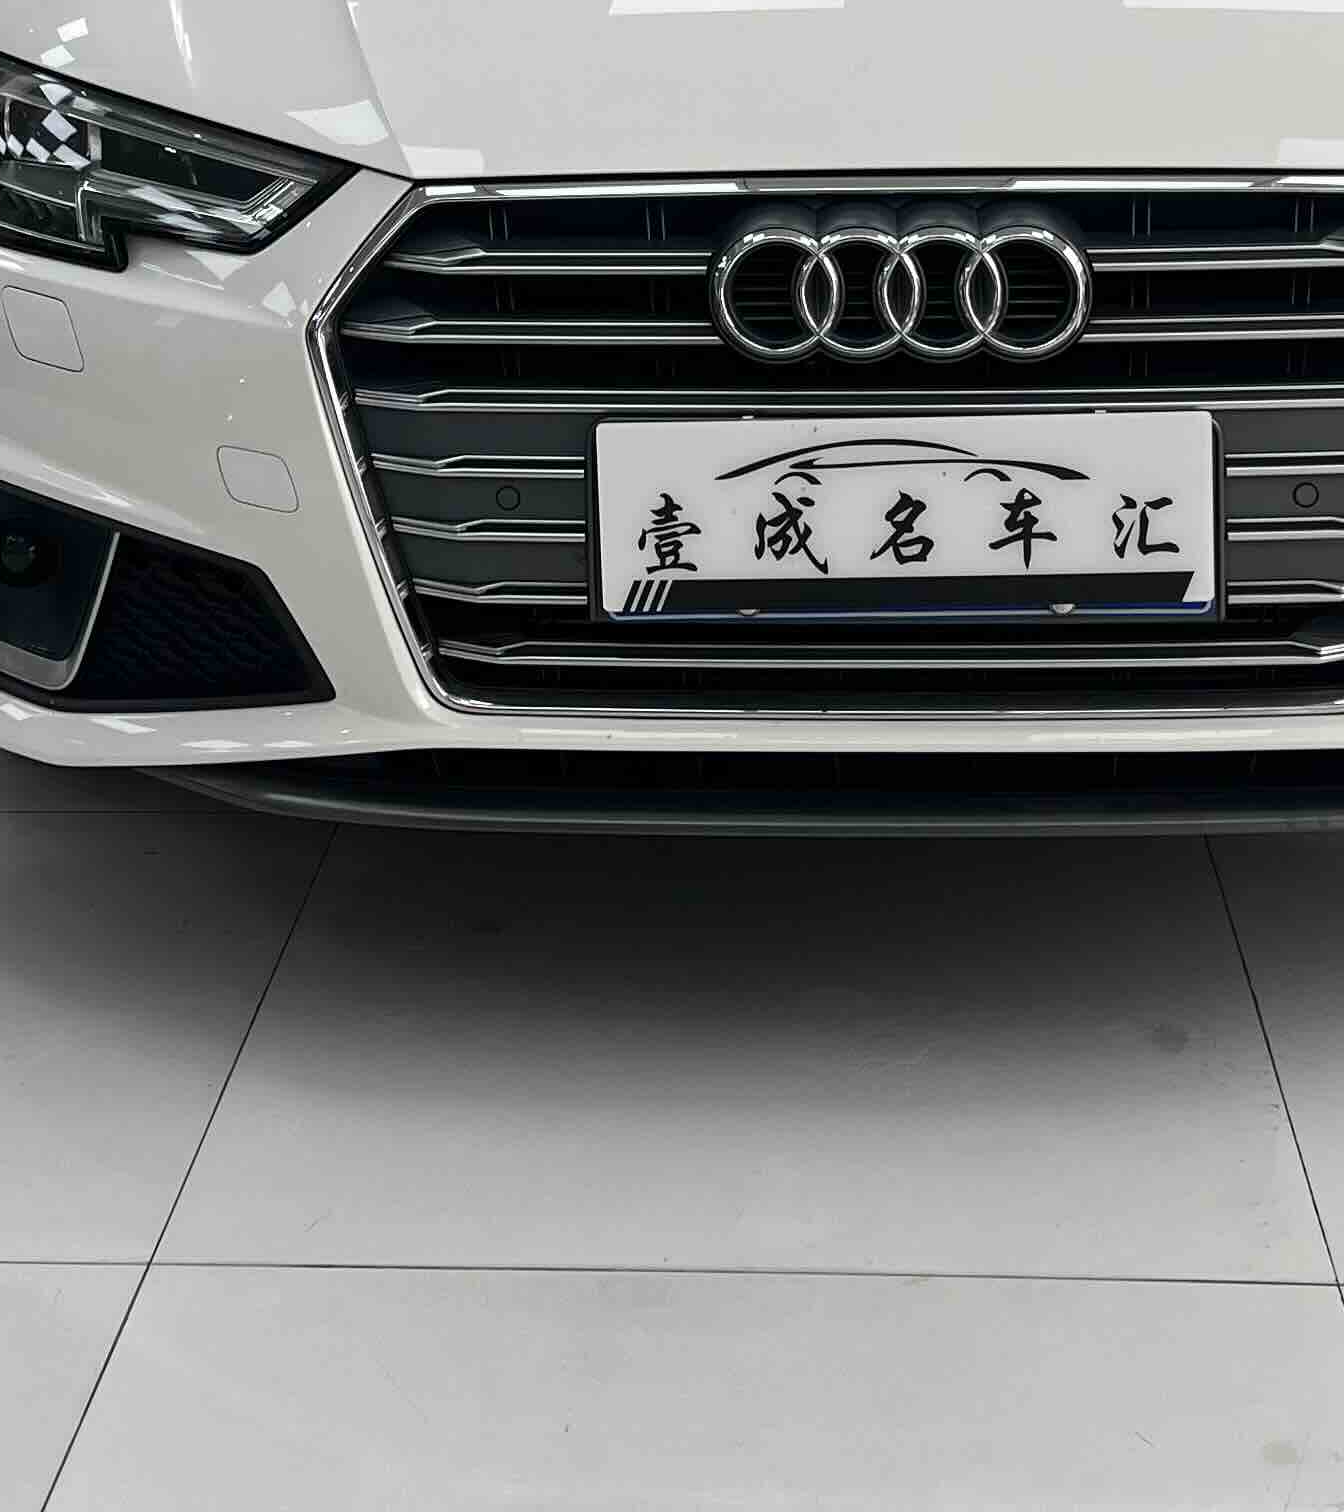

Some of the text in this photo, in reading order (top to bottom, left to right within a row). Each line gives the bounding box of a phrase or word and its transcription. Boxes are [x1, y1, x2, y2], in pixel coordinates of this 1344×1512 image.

[637, 489, 1181, 576] 壹成名车汇
